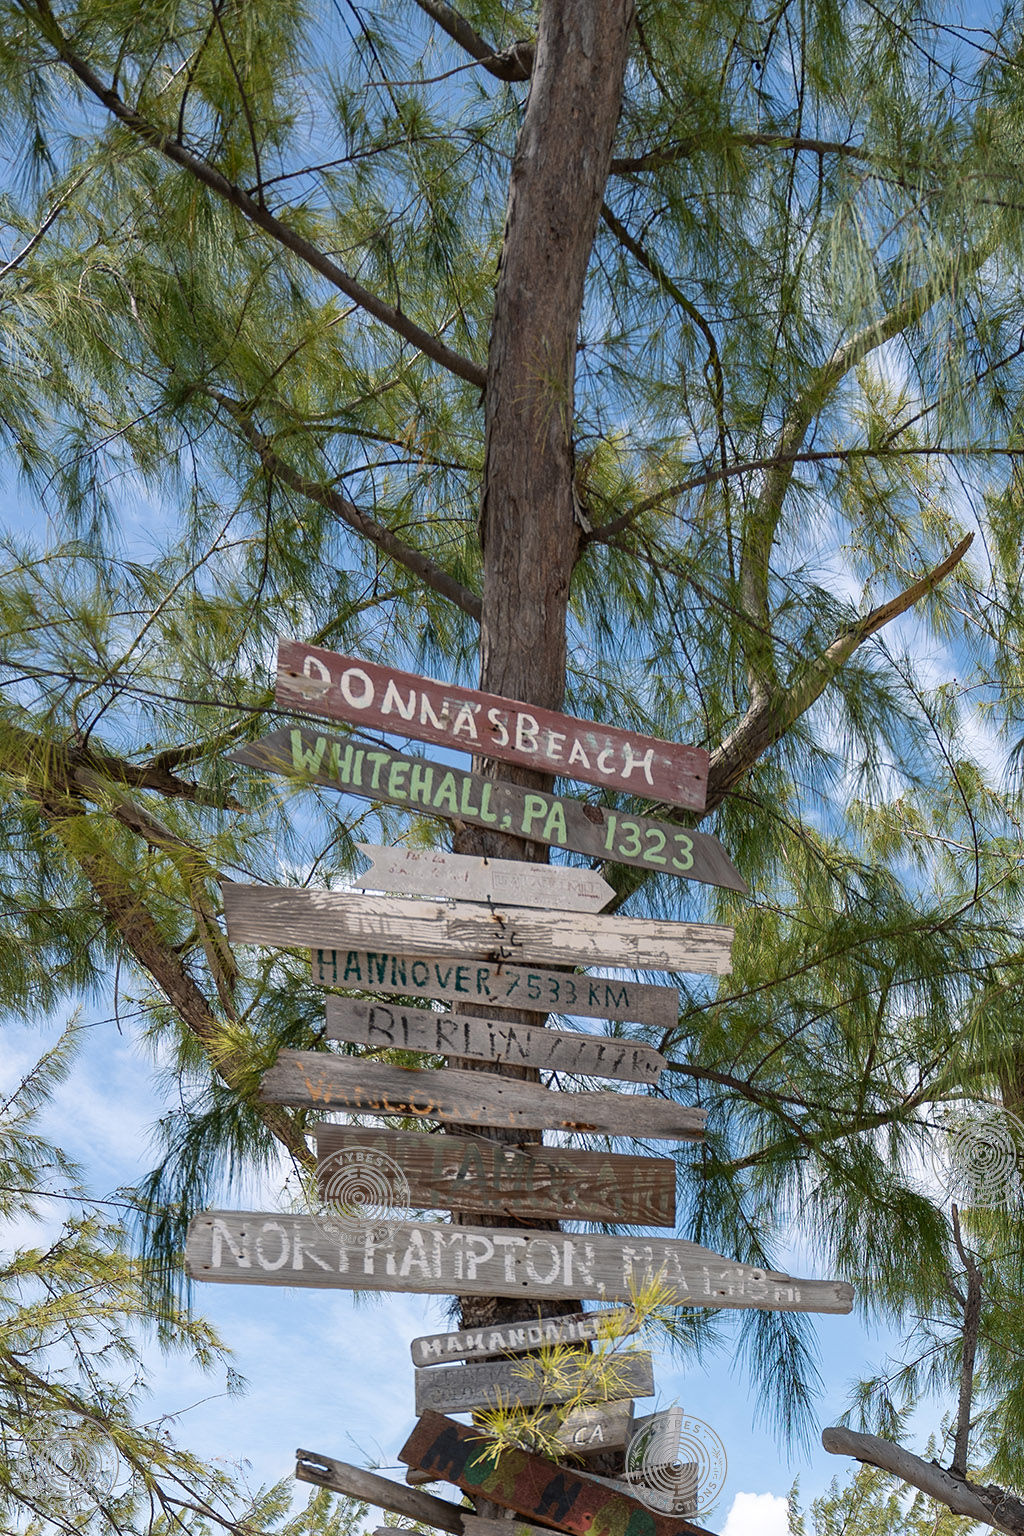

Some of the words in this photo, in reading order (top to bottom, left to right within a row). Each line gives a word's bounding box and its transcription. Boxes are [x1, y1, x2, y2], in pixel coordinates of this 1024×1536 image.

[522, 794, 568, 845] PA
[605, 813, 695, 871] 1323
[316, 949, 491, 996] HANNOVER
[505, 970, 579, 1003] 7533
[588, 983, 631, 1010] KM
